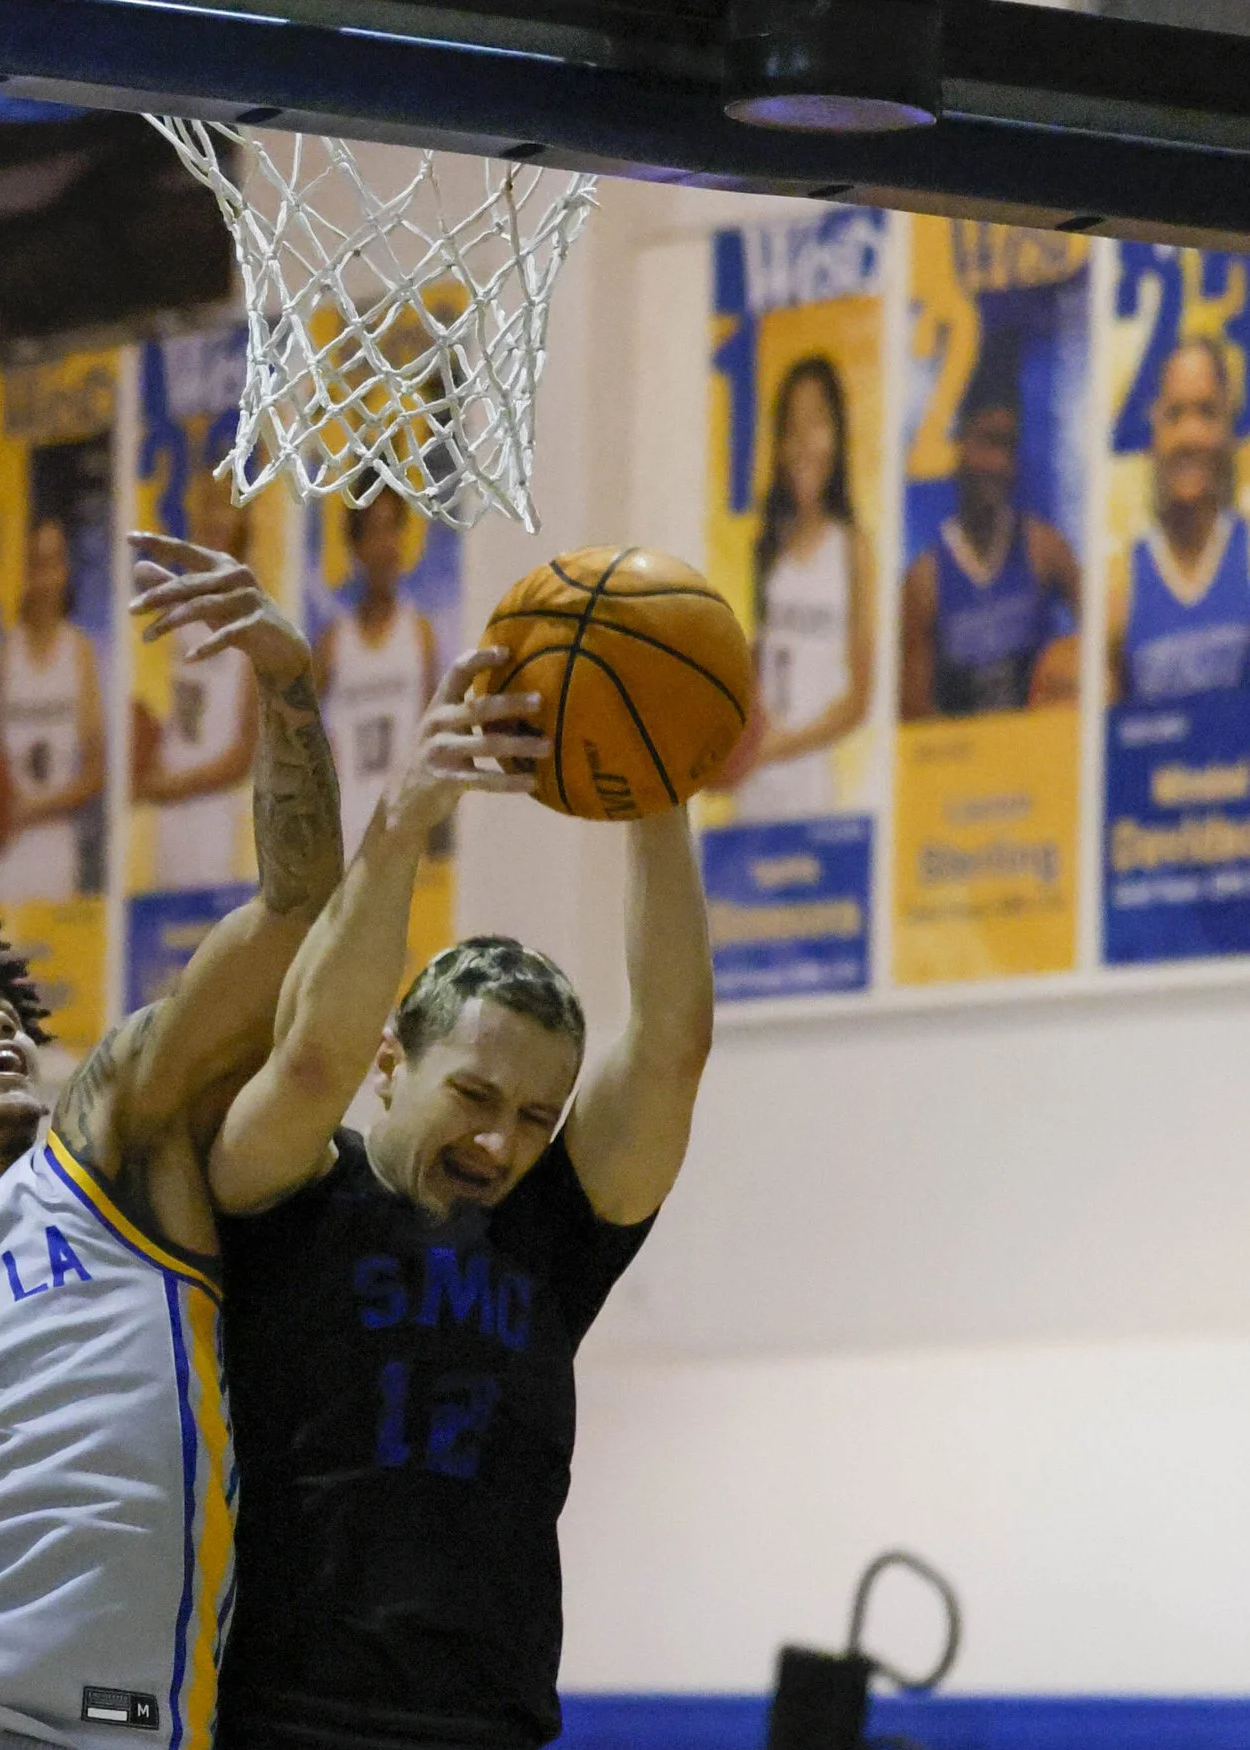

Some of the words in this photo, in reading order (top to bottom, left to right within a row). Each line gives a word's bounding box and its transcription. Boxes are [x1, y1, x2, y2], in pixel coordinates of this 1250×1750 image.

[2, 1225, 92, 1301] LA
[376, 1362, 502, 1480] 12
[137, 1703, 150, 1719] M
